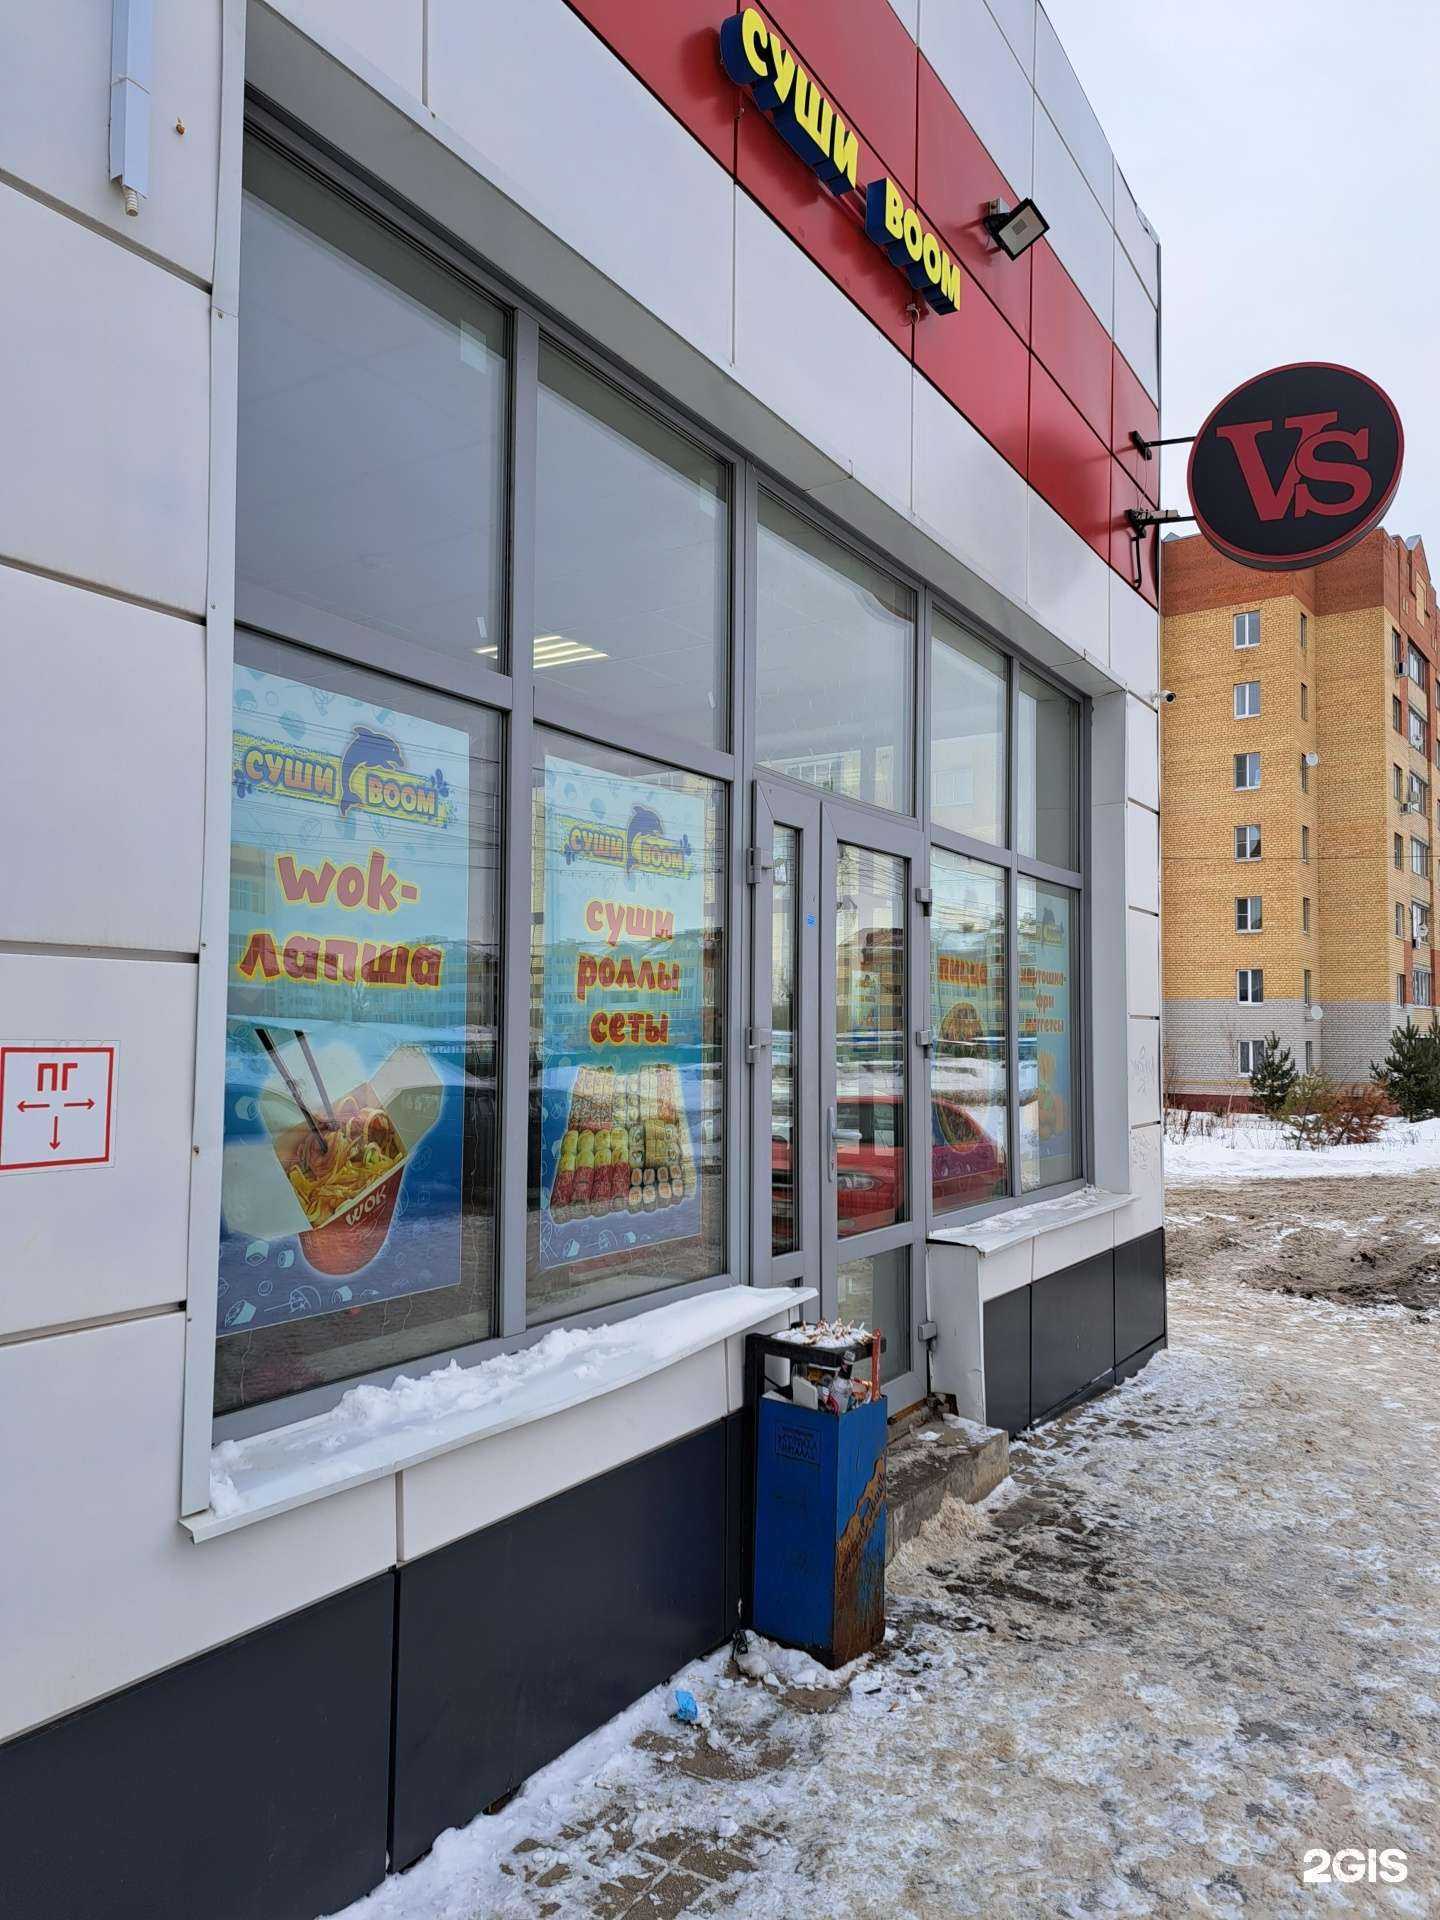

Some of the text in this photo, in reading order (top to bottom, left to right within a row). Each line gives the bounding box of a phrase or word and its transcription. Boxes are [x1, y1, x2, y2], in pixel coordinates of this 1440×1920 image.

[739, 7, 859, 191] СУШИ
[1216, 411, 1373, 522] VS
[245, 749, 334, 796] СУШИ
[569, 827, 624, 863] СУШИ
[276, 850, 418, 912] wok-
[585, 900, 675, 947] суши
[239, 932, 443, 987] лапша
[576, 953, 680, 1001] роллы
[589, 1012, 669, 1043] сеты
[37, 1062, 78, 1092] ПГ
